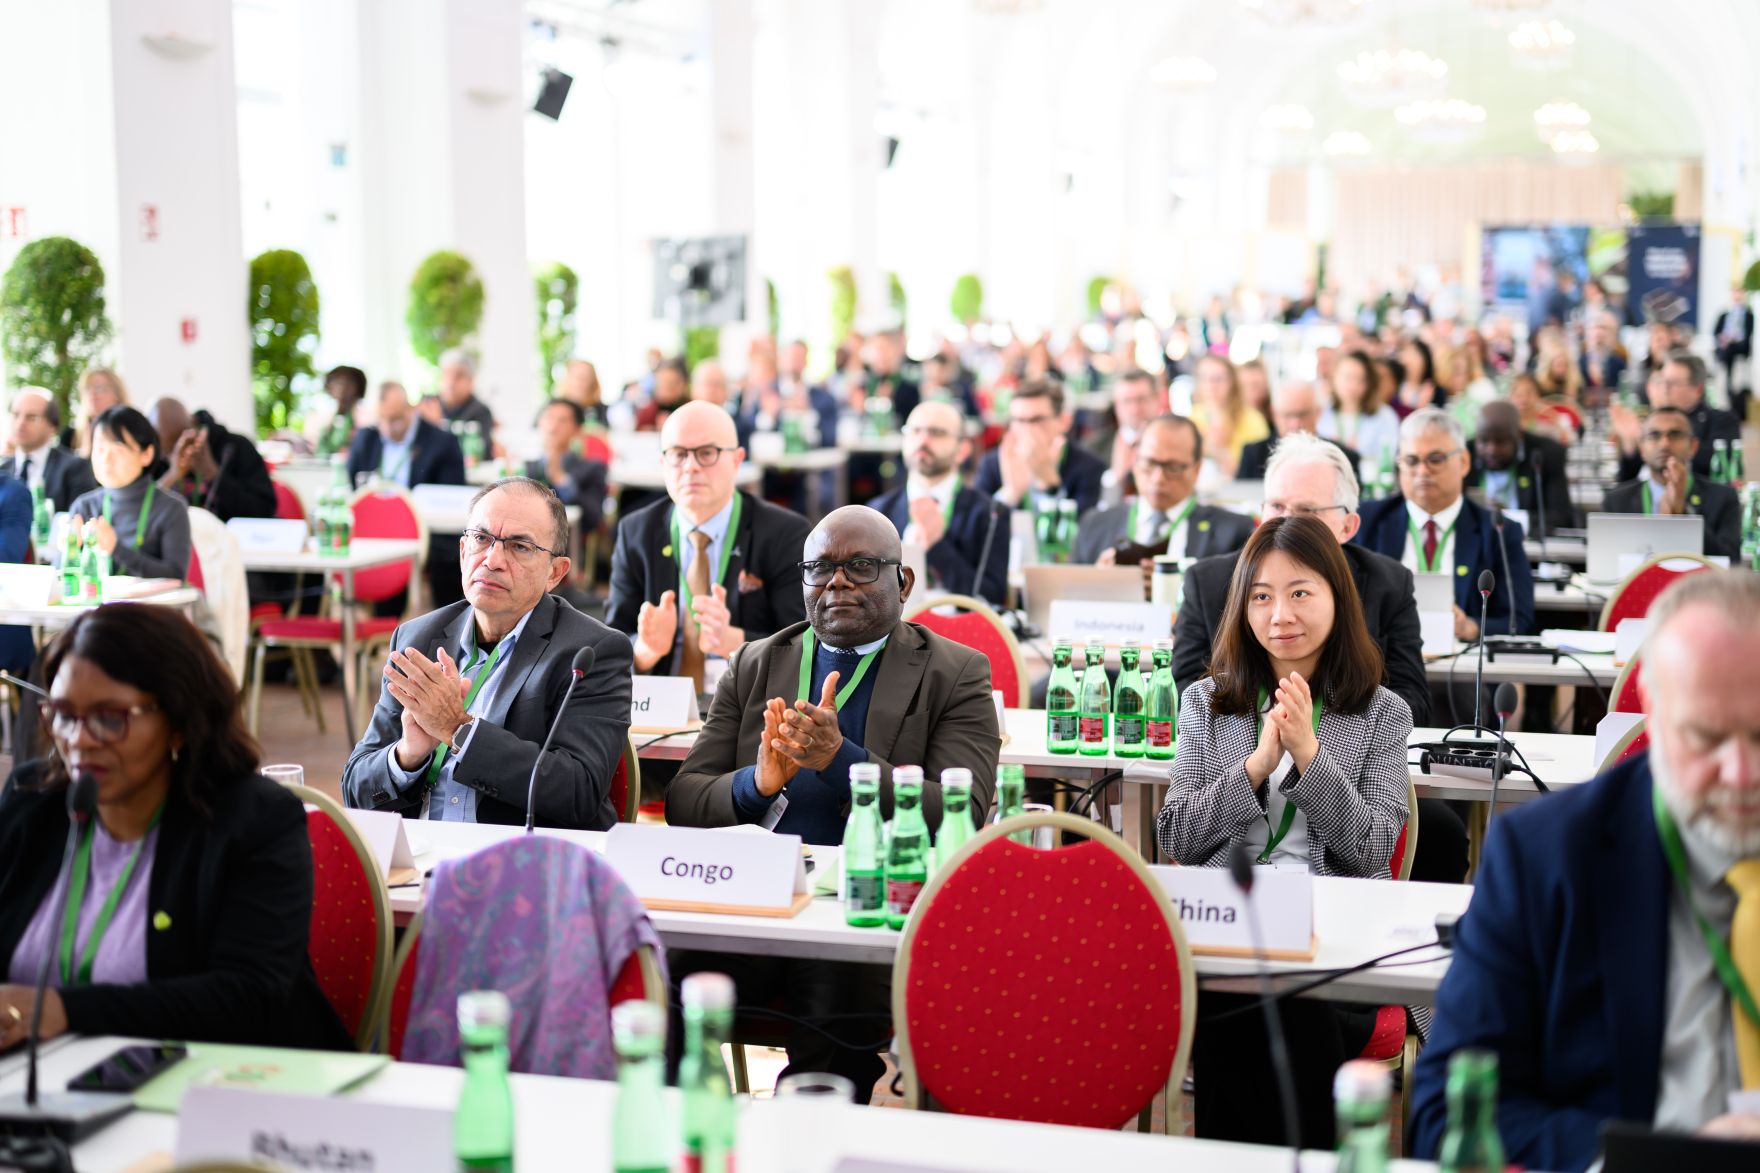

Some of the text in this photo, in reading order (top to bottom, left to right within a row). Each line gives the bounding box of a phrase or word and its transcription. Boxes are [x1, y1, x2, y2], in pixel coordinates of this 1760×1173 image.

[1074, 619, 1145, 632] Indonesia
[661, 856, 733, 884] Congo
[1172, 897, 1236, 923] hina
